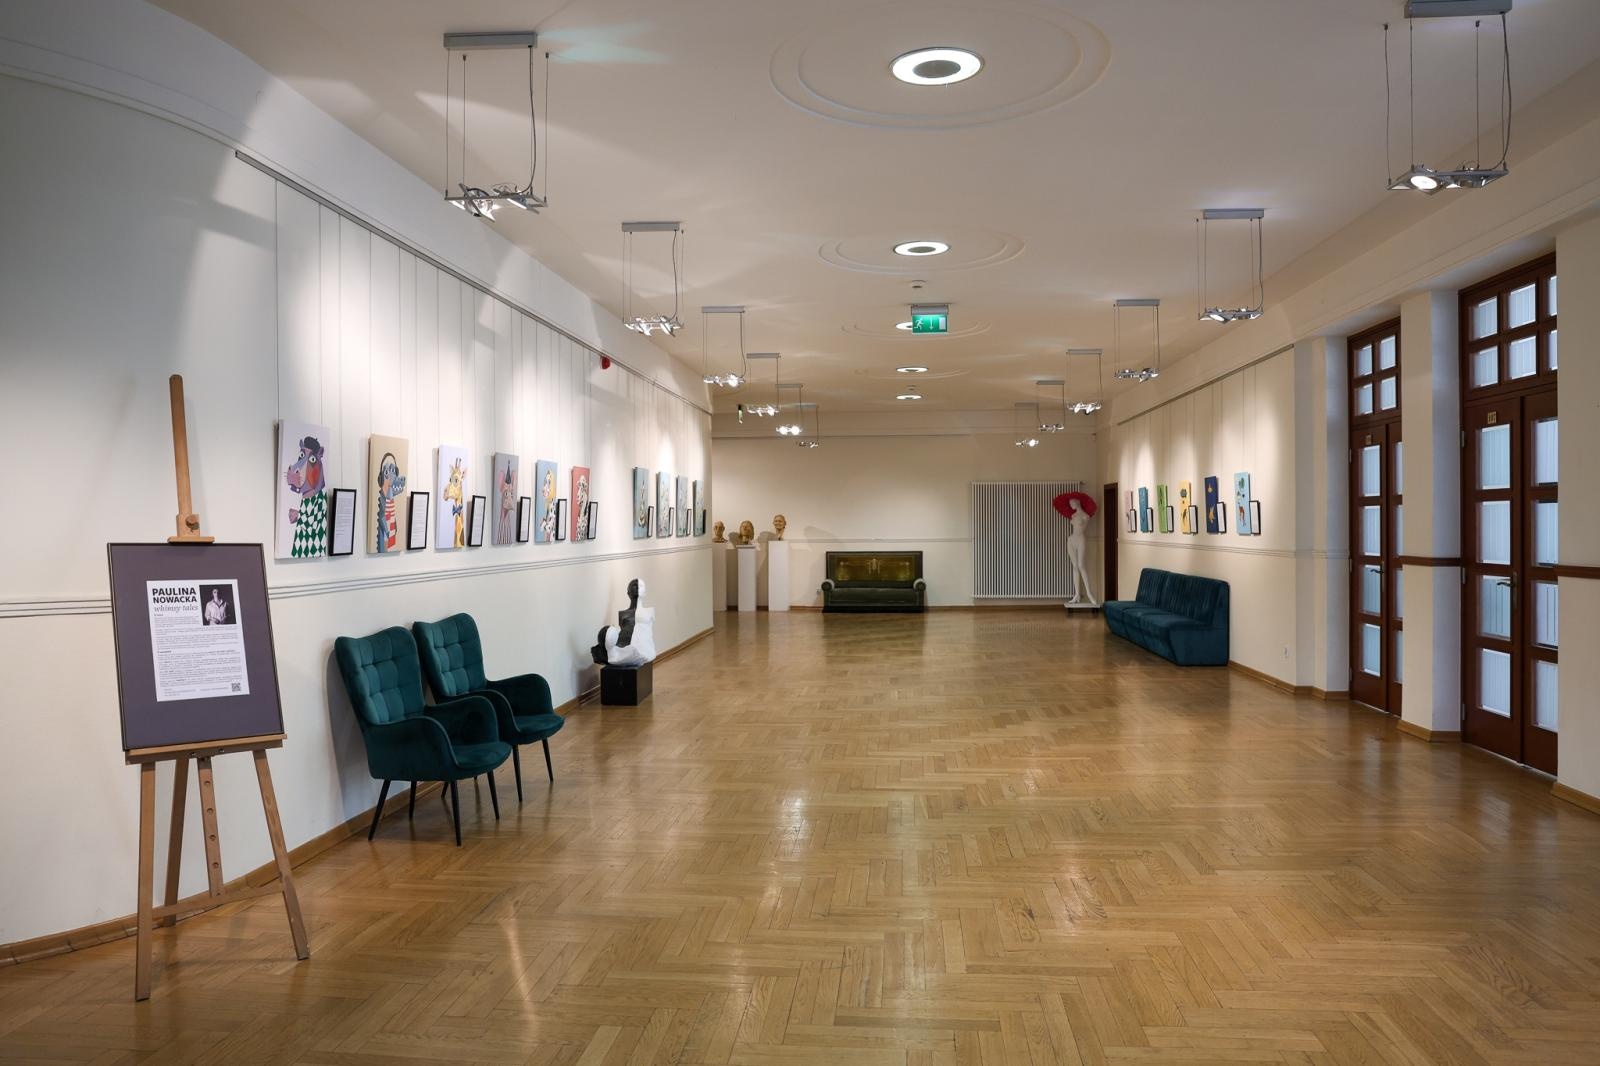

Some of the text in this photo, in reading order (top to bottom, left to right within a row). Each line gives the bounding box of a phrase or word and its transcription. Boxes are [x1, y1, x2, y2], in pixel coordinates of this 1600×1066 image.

[152, 587, 196, 596] PAULINA
[153, 596, 197, 604] NOWACKA
[154, 605, 181, 613] whimsy
